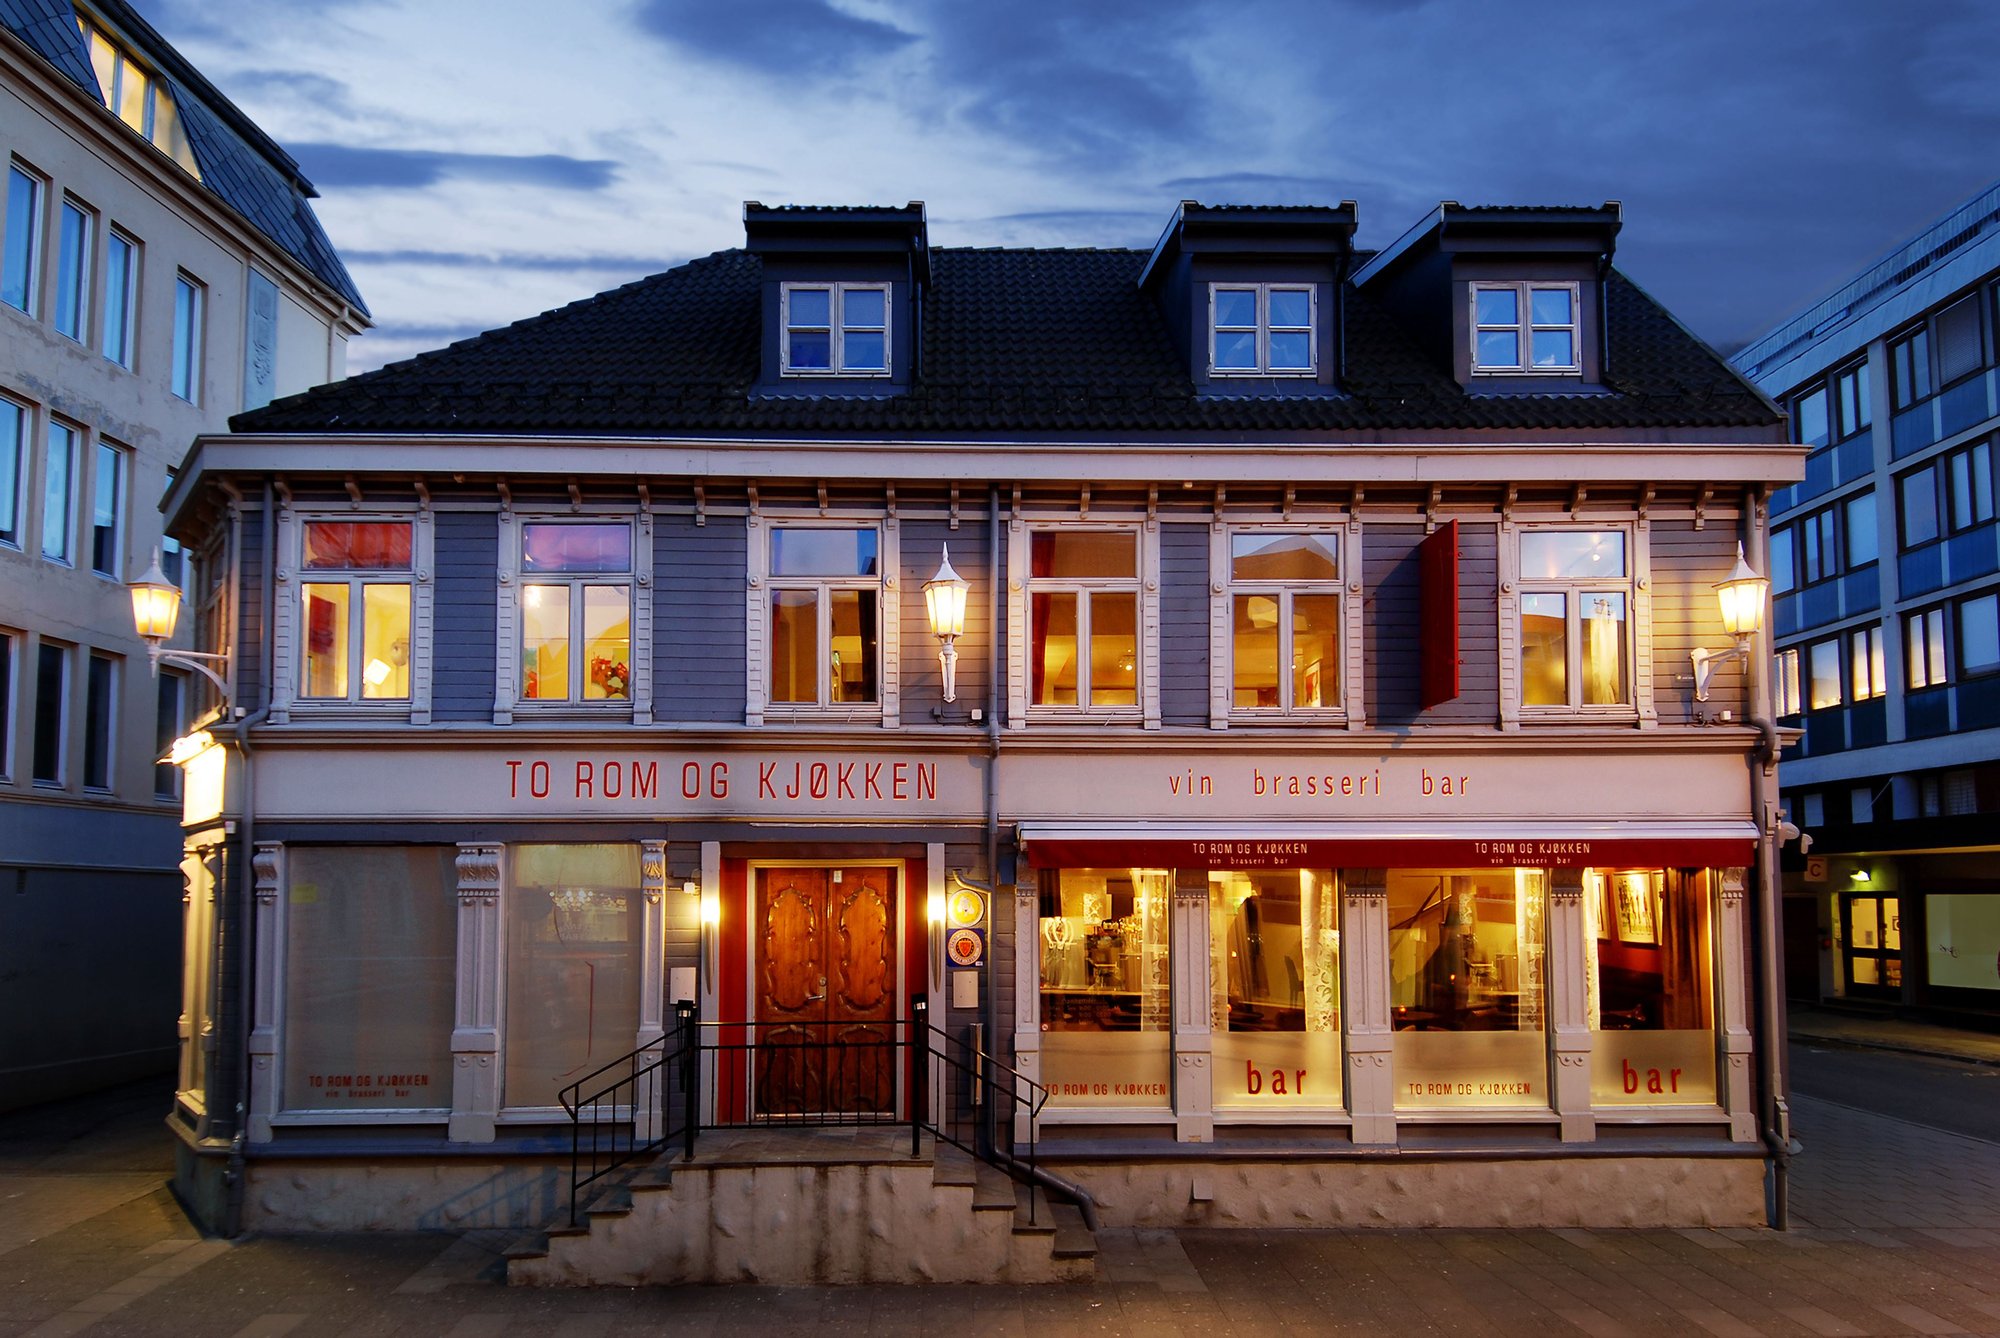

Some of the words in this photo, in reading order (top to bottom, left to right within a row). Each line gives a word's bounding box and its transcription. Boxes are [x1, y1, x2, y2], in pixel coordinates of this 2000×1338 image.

[506, 761, 551, 798] TO
[575, 761, 657, 799] ROM
[681, 761, 729, 799] OG
[758, 762, 937, 800] KJØKKEN
[1169, 768, 1214, 796] vin
[1254, 768, 1381, 797] brasseri
[1422, 768, 1470, 796] bar
[1193, 843, 1206, 854] TO
[1210, 843, 1233, 854] ROM
[1237, 843, 1250, 854] OG
[1257, 843, 1308, 854] KJØKKEN
[1475, 842, 1488, 854] TO
[1493, 842, 1515, 854] ROM
[1520, 842, 1533, 854] OG
[1539, 842, 1590, 854] KJØKKEN
[1230, 856, 1265, 865] brasseri
[1274, 856, 1288, 865] bar
[1491, 856, 1504, 864] vin
[1513, 856, 1548, 864] brasseri
[1557, 856, 1571, 864] bar
[1810, 864, 1821, 877] C
[309, 1075, 323, 1087] TO
[328, 1075, 353, 1087] ROM
[356, 1075, 371, 1087] OG
[377, 1074, 429, 1086] KJØKKEN
[1247, 1059, 1307, 1095] bar
[1622, 1058, 1682, 1094] bar
[1045, 1084, 1059, 1095] TO
[1064, 1084, 1088, 1095] ROM
[1093, 1084, 1108, 1095] OG
[1115, 1084, 1167, 1095] KJØKKEN
[1409, 1083, 1422, 1095] TO
[1428, 1083, 1452, 1095] ROM
[1458, 1083, 1472, 1095] OG
[1479, 1083, 1531, 1095] KJØKKEN
